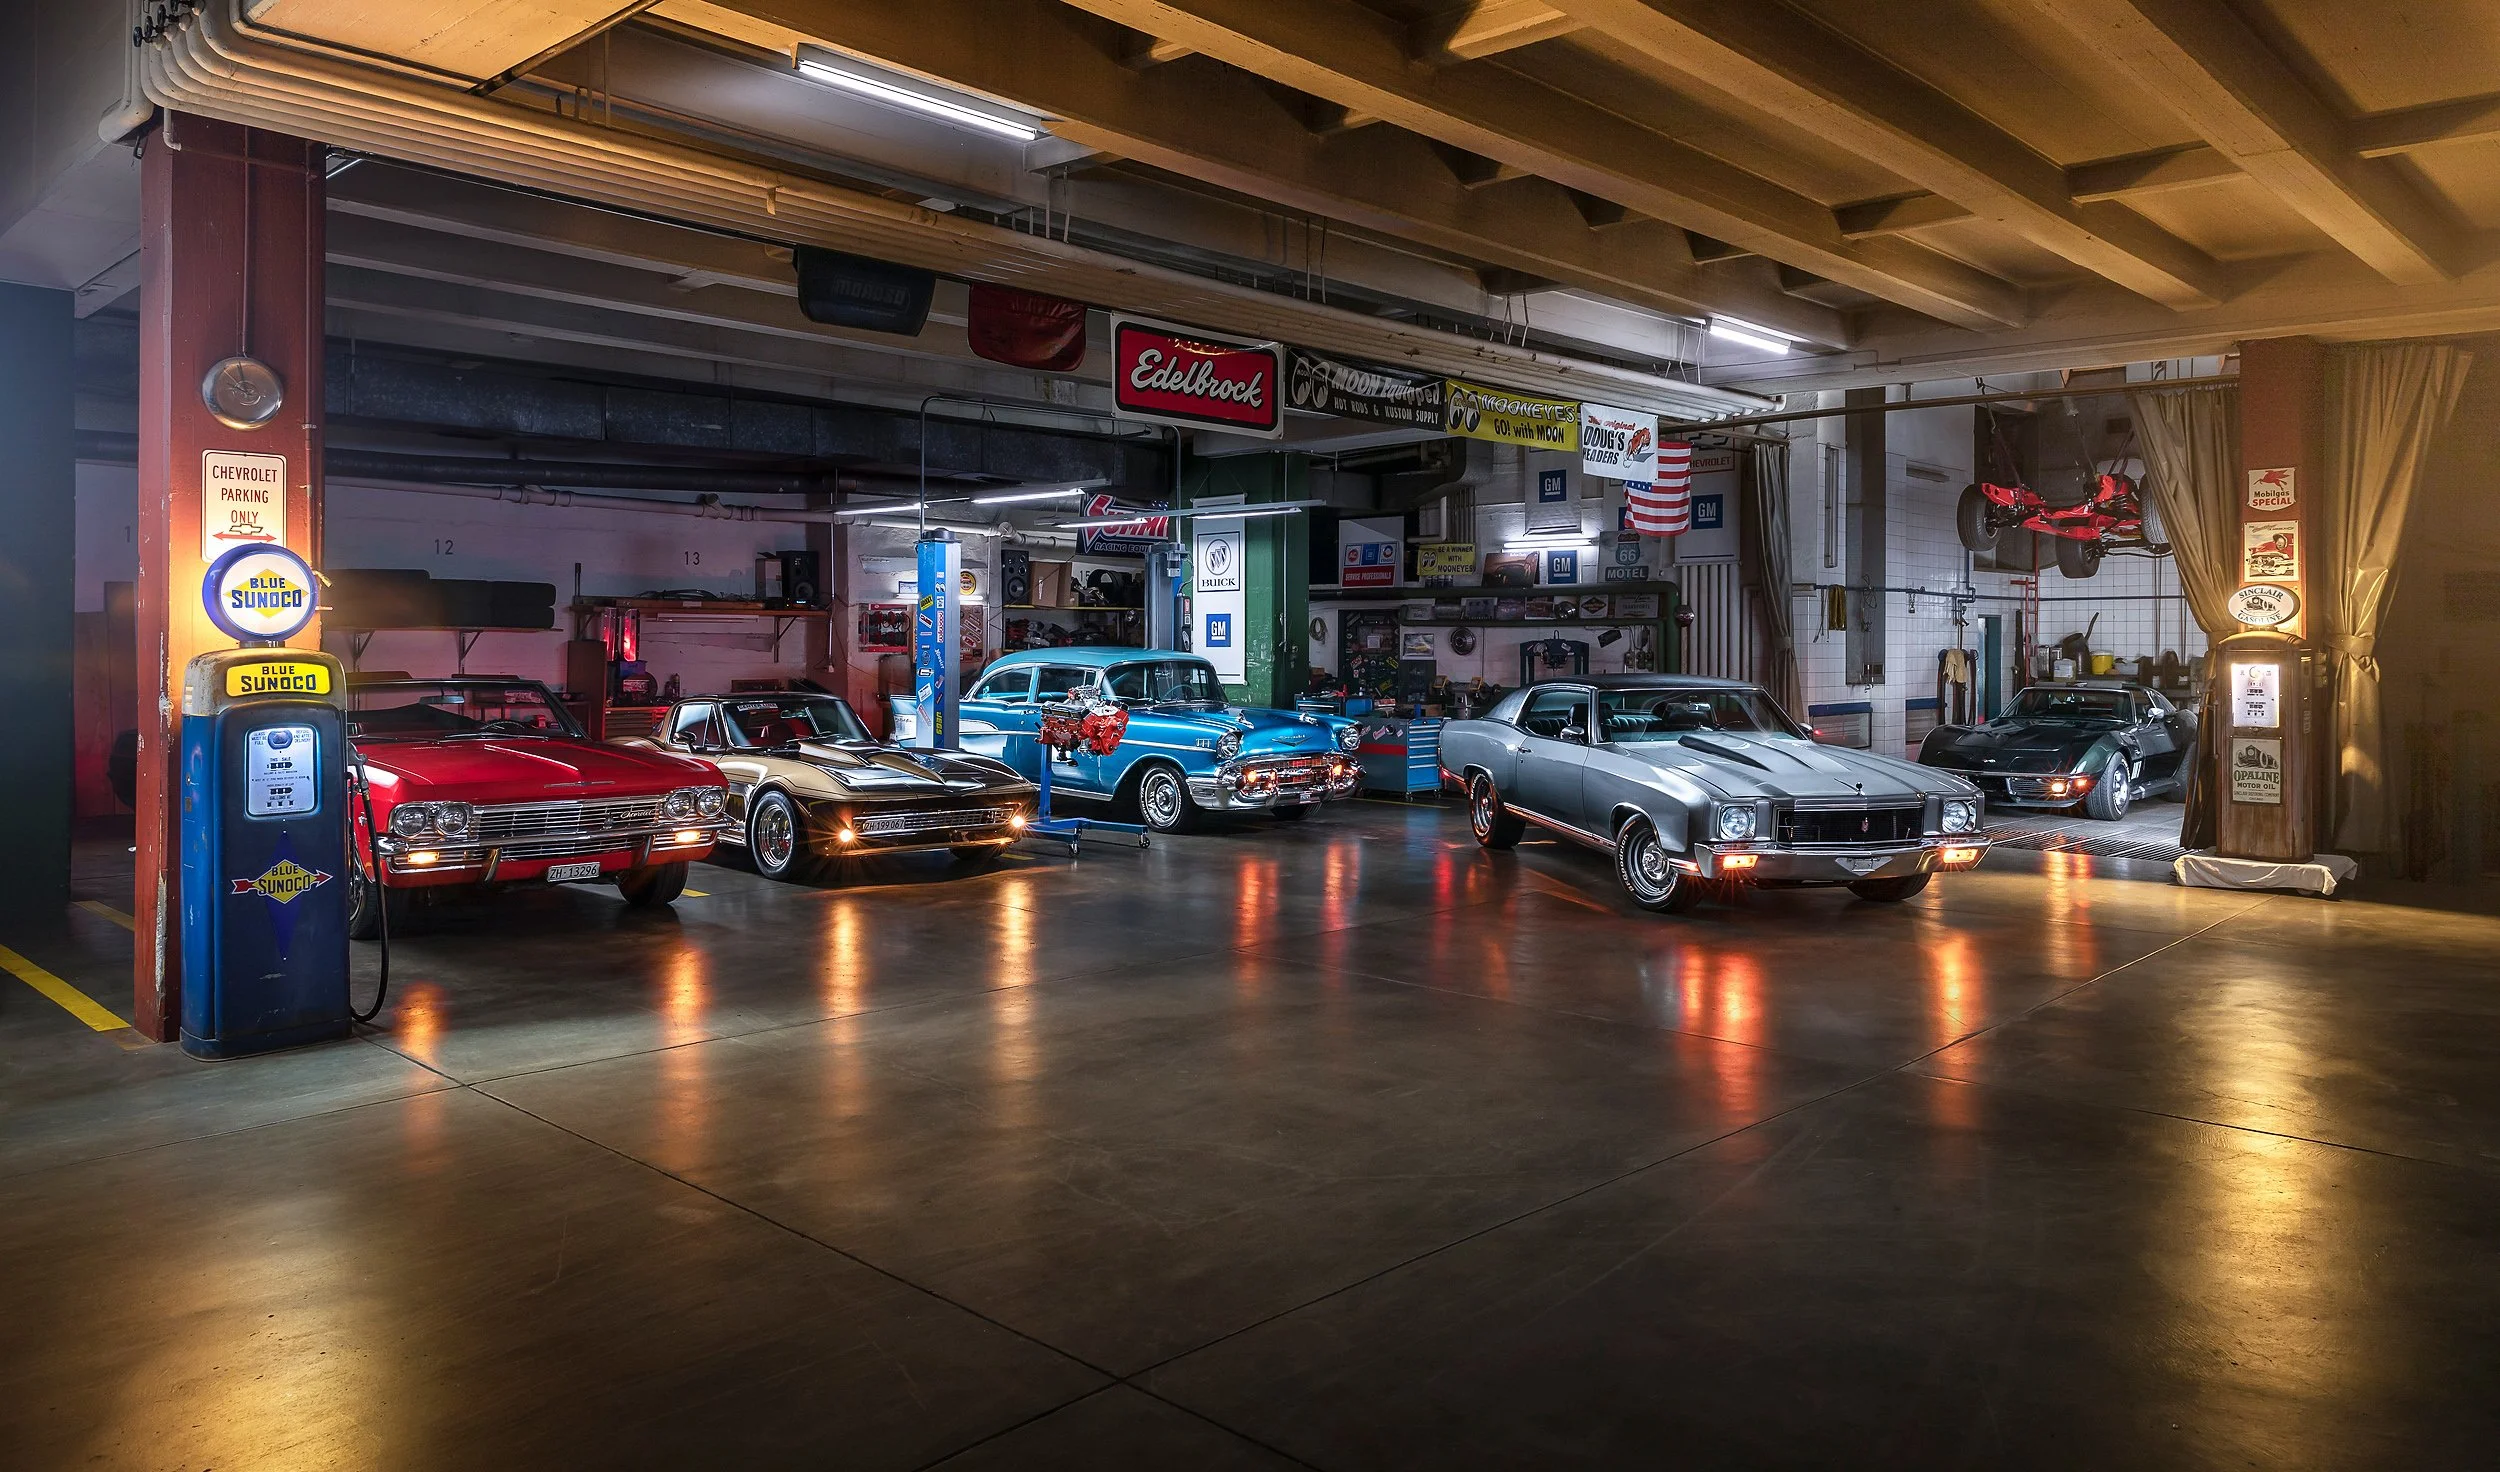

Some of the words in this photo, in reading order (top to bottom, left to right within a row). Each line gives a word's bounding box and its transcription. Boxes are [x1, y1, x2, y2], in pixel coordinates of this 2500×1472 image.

[1131, 349, 1263, 407] Edelbrock
[1331, 367, 1380, 396] MOON
[1334, 396, 1347, 411] HOT
[1352, 401, 1368, 415] RODS
[1373, 406, 1379, 416] &
[1385, 406, 1412, 421] KUSTOM
[1416, 410, 1439, 425] SUPPLY
[1481, 394, 1575, 423] MOONEYES
[1588, 415, 1601, 425] The
[1494, 418, 1511, 436] GO!
[1513, 422, 1534, 439] with
[1536, 425, 1564, 443] MOON
[1584, 425, 1625, 451] DOUG'S
[1690, 457, 1730, 468] HEVROLET
[212, 465, 277, 483] CHEVROLET
[1545, 477, 1560, 492] GM
[221, 488, 269, 503] PARKING
[2253, 490, 2290, 499] Mobilgas
[1698, 502, 1716, 517] GM
[2252, 498, 2292, 507] SPECIAL
[231, 510, 258, 524] ONLY
[434, 539, 454, 555] 12
[1094, 542, 1127, 552] RACING
[684, 551, 700, 565] 13
[1620, 550, 1636, 561] 66
[1554, 557, 1571, 572] GM
[1345, 573, 1360, 581] SERVICE
[1362, 572, 1391, 580] PROFESSIONALS
[1607, 568, 1645, 579] MOTEL
[249, 577, 285, 589] BLUE
[1202, 578, 1236, 587] BUICK
[231, 588, 302, 609] SUNOCO
[2239, 587, 2284, 600] SINCLAIR
[2238, 612, 2282, 624] GASOLINE
[1211, 621, 1226, 636] GM
[262, 666, 295, 675] BLUE
[241, 674, 316, 692] SUNOCO
[2233, 770, 2279, 784] OPALINE
[877, 821, 889, 829] 199
[272, 865, 298, 876] BLUE
[259, 875, 310, 894] SUNOCO
